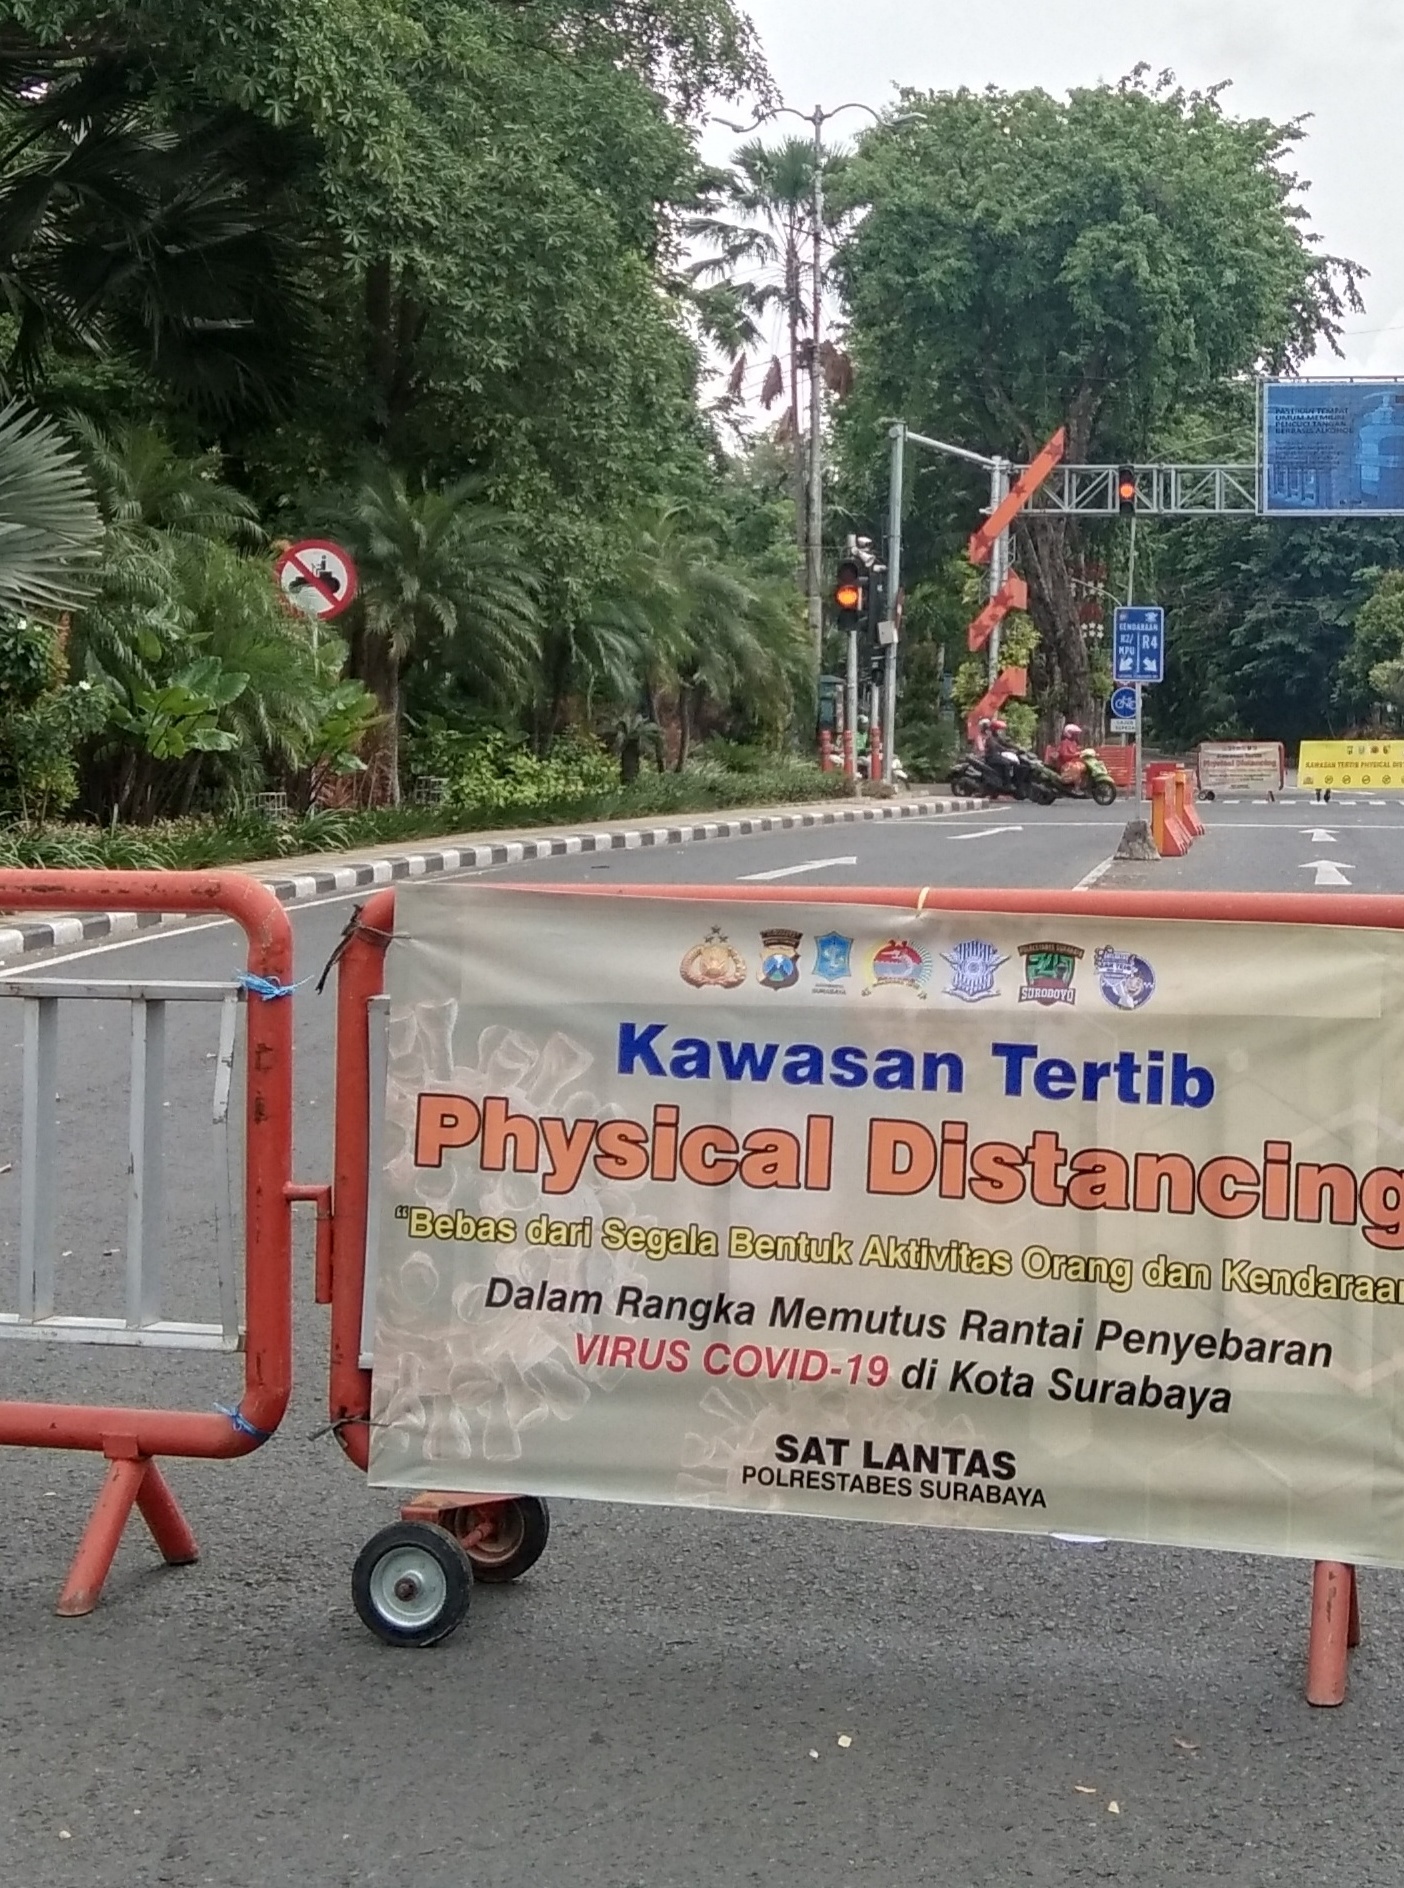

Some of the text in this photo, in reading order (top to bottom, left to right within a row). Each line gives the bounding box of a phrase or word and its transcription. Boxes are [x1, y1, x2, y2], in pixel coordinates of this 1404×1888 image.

[1118, 646, 1135, 656] MPU
[1142, 634, 1158, 649] R4
[1021, 988, 1074, 1001] SUROBOYO
[617, 1022, 1216, 1109] Kawasan Tertib
[414, 1093, 834, 1195] Physical
[525, 1214, 593, 1248] dari
[601, 1217, 719, 1261] Segala
[728, 1226, 853, 1266] Bentuk
[861, 1234, 1013, 1277] Aktivitas
[1021, 1245, 1133, 1293] Orang
[1143, 1254, 1211, 1291] dan
[484, 1276, 1334, 1369] Dalam Rangka Memutus Rantai Penyebaran
[574, 1333, 1233, 1420] VIRUS COVID-19 di Kota Surabaya
[742, 1465, 1048, 1509] POLRESTABES SURABAYA
[775, 1433, 1018, 1481] SAT LANTAS
